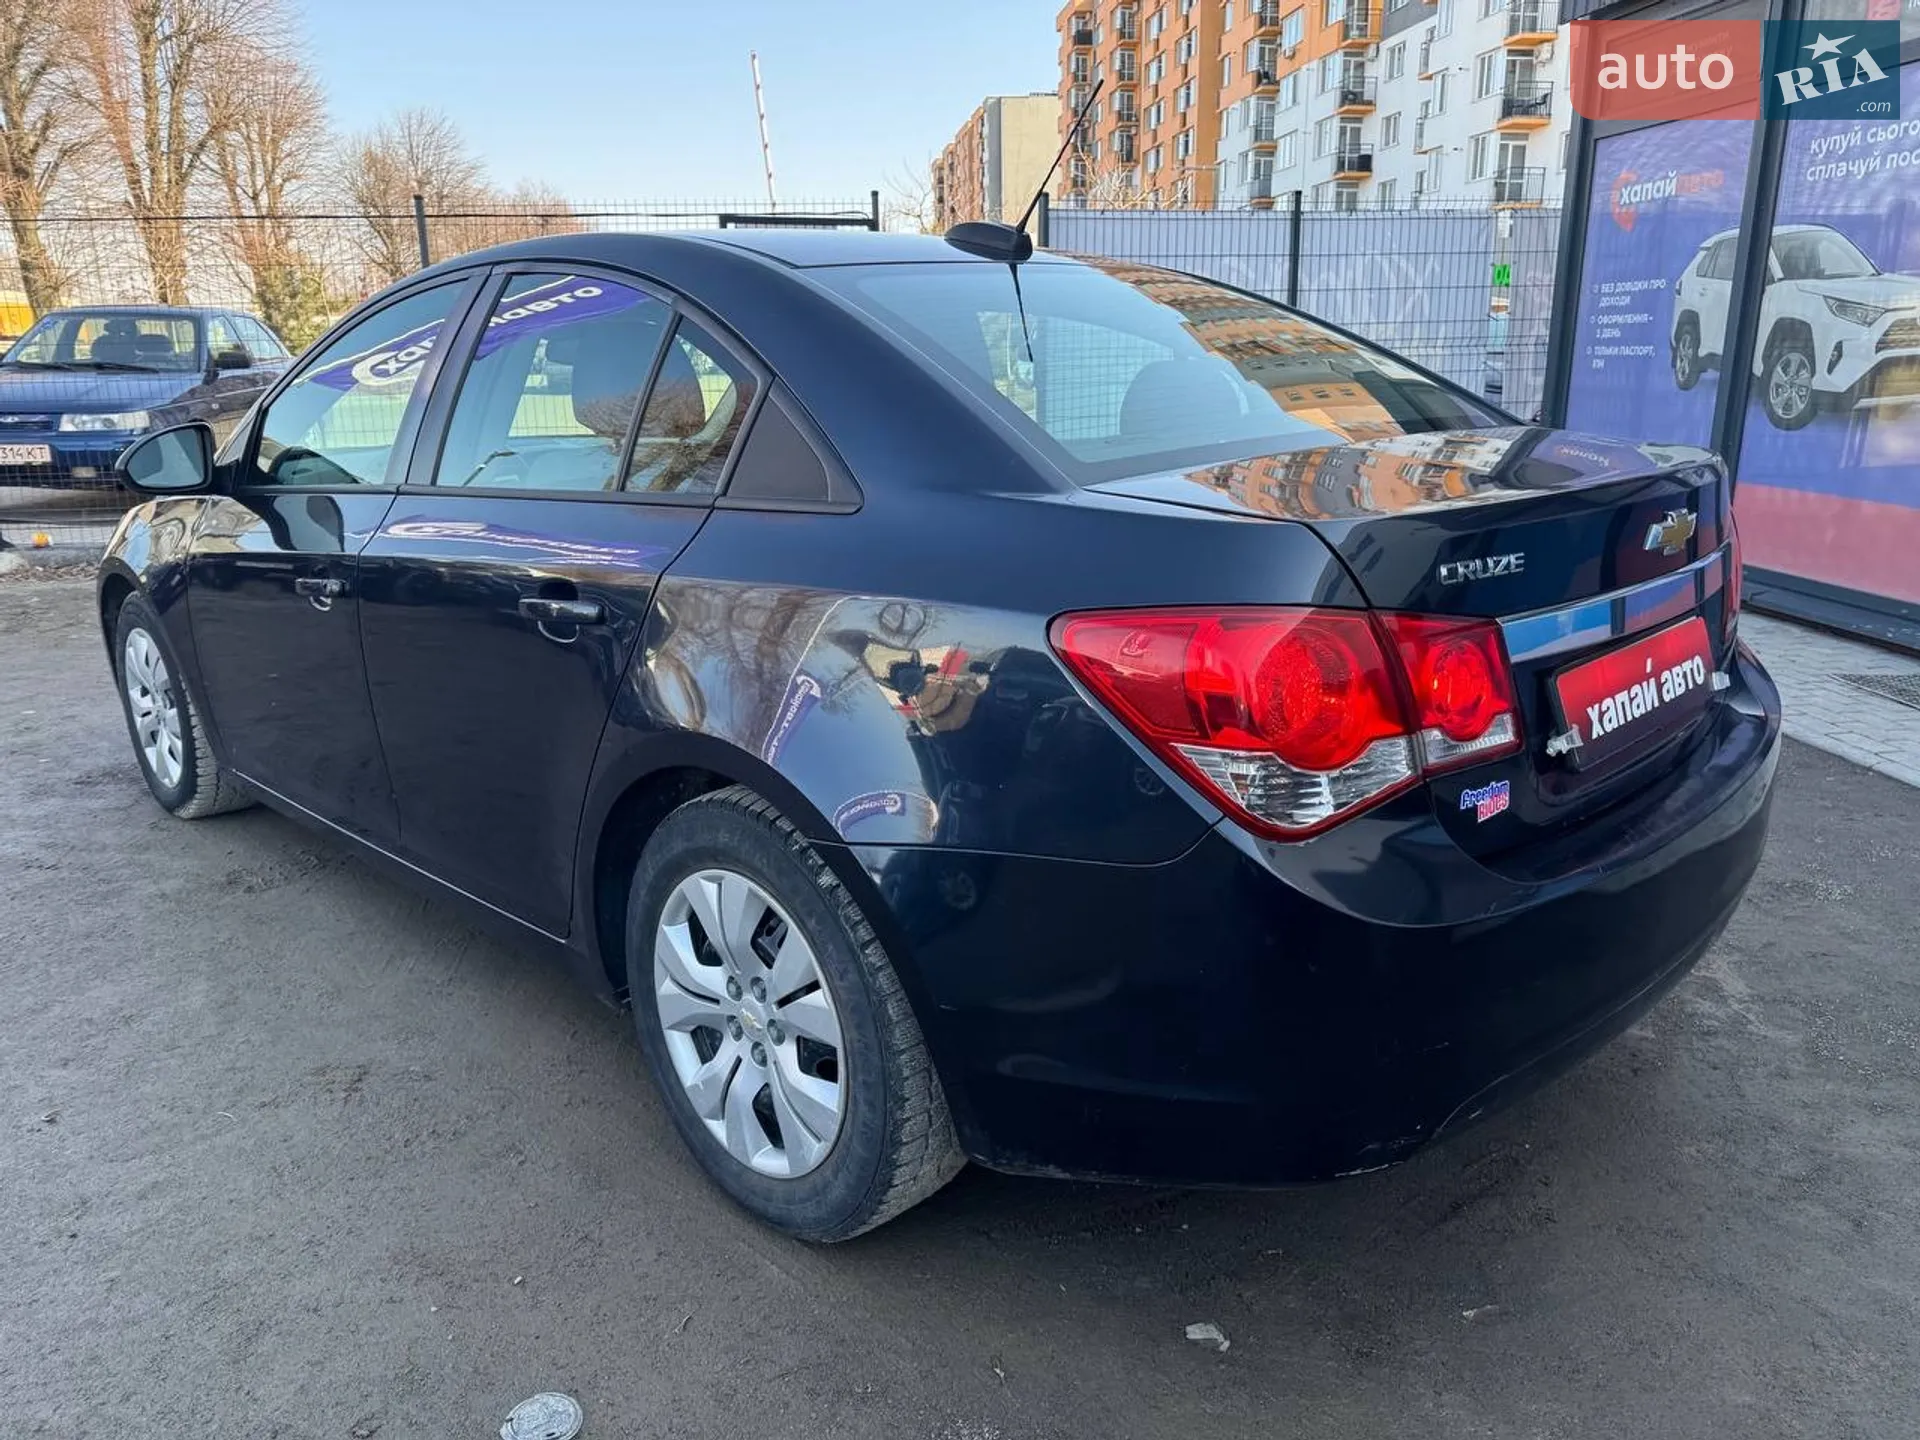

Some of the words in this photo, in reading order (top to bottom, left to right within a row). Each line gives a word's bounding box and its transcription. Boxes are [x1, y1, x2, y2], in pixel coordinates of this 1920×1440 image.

[1810, 125, 1862, 158] купуй
[1806, 149, 1881, 181] сплачуй
[1439, 552, 1525, 586] CRUZE
[1586, 657, 1659, 740] хапай
[1660, 655, 1705, 703] авто
